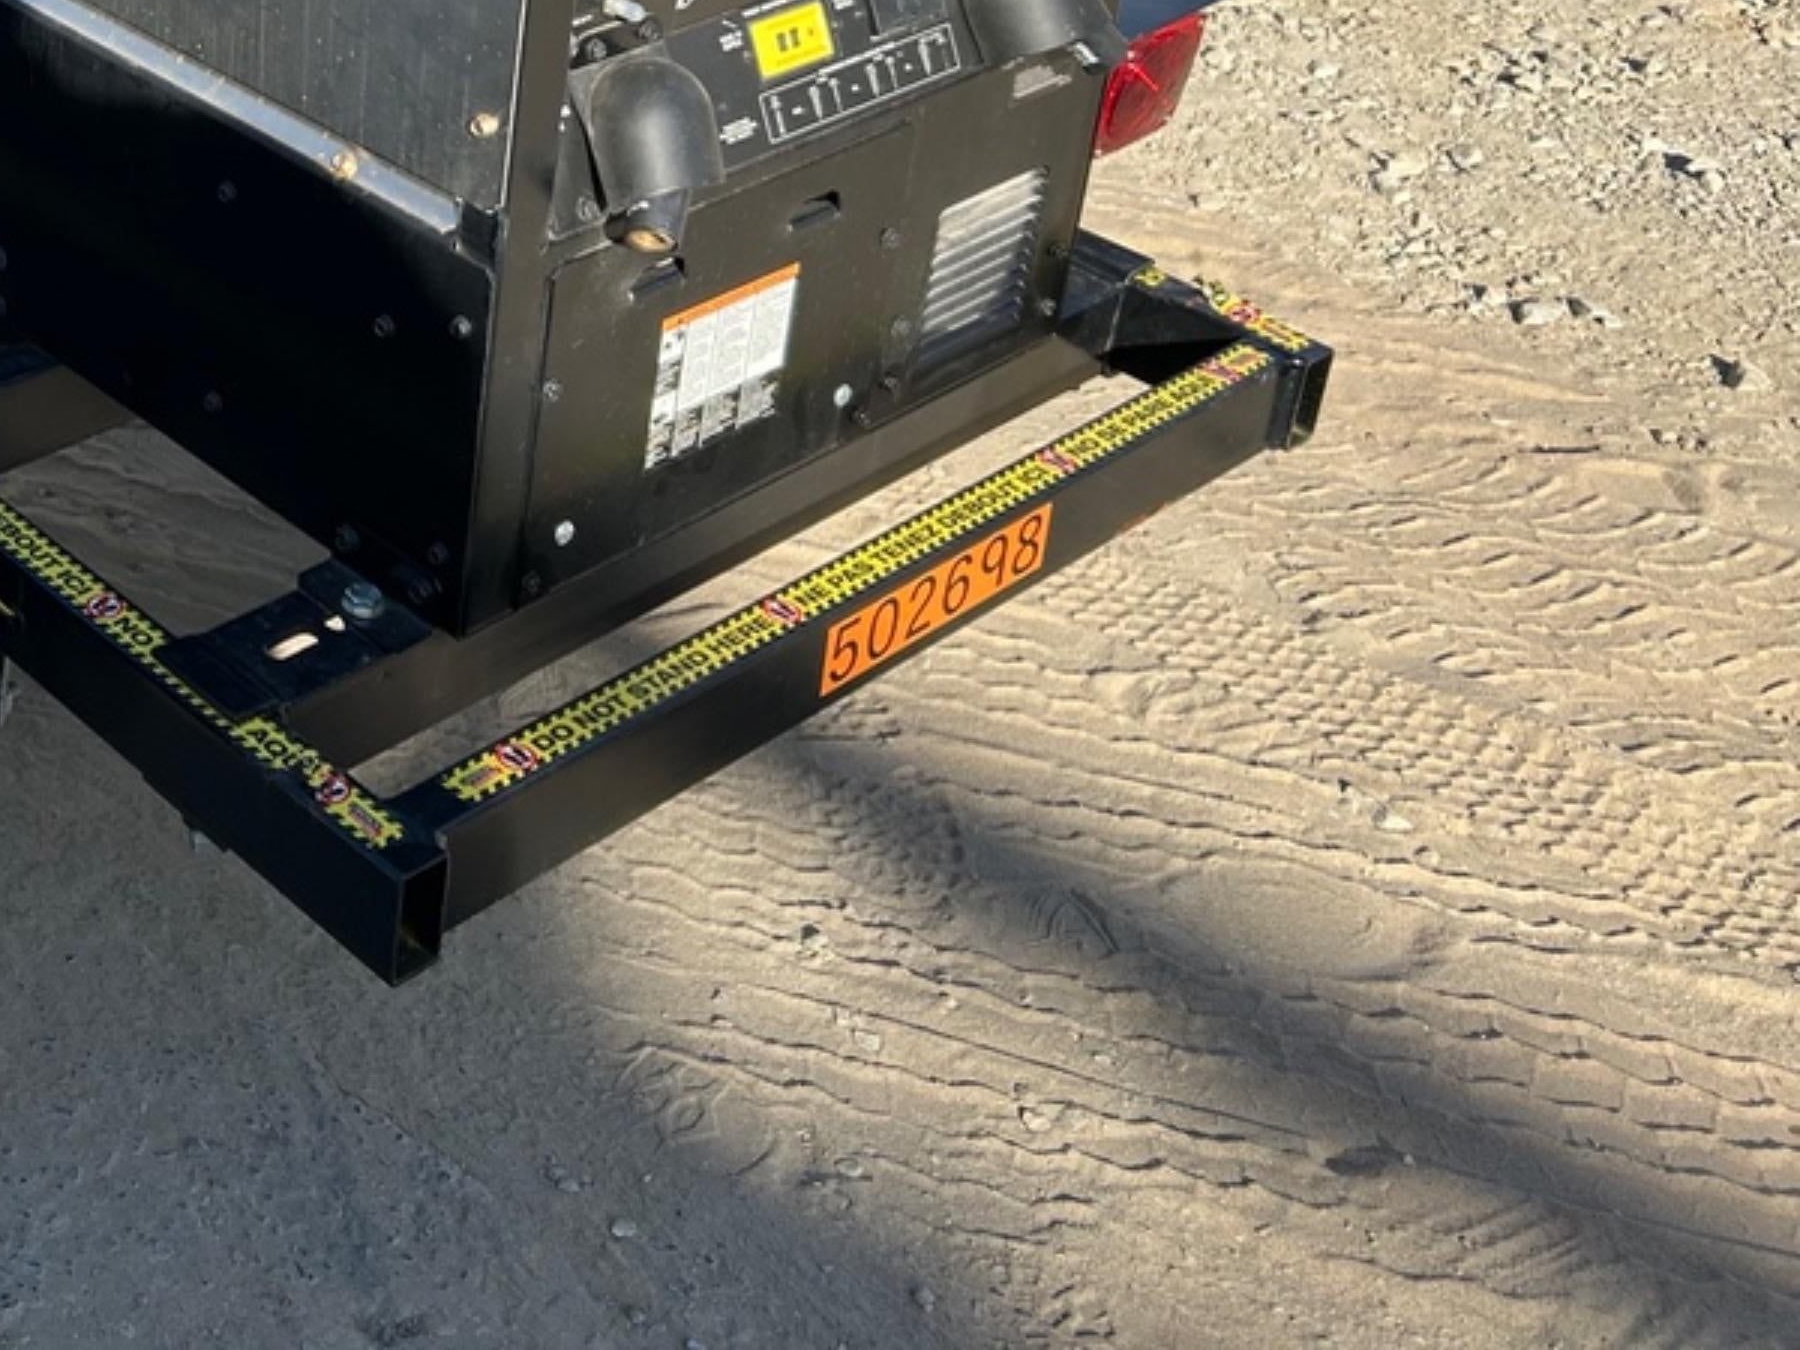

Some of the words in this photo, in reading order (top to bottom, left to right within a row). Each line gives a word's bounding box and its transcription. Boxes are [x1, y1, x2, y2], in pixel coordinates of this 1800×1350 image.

[114, 617, 153, 646] NO
[828, 513, 1043, 683] 502698
[532, 723, 575, 752] DO
[578, 692, 624, 730] NOT
[627, 650, 711, 699] STAND
